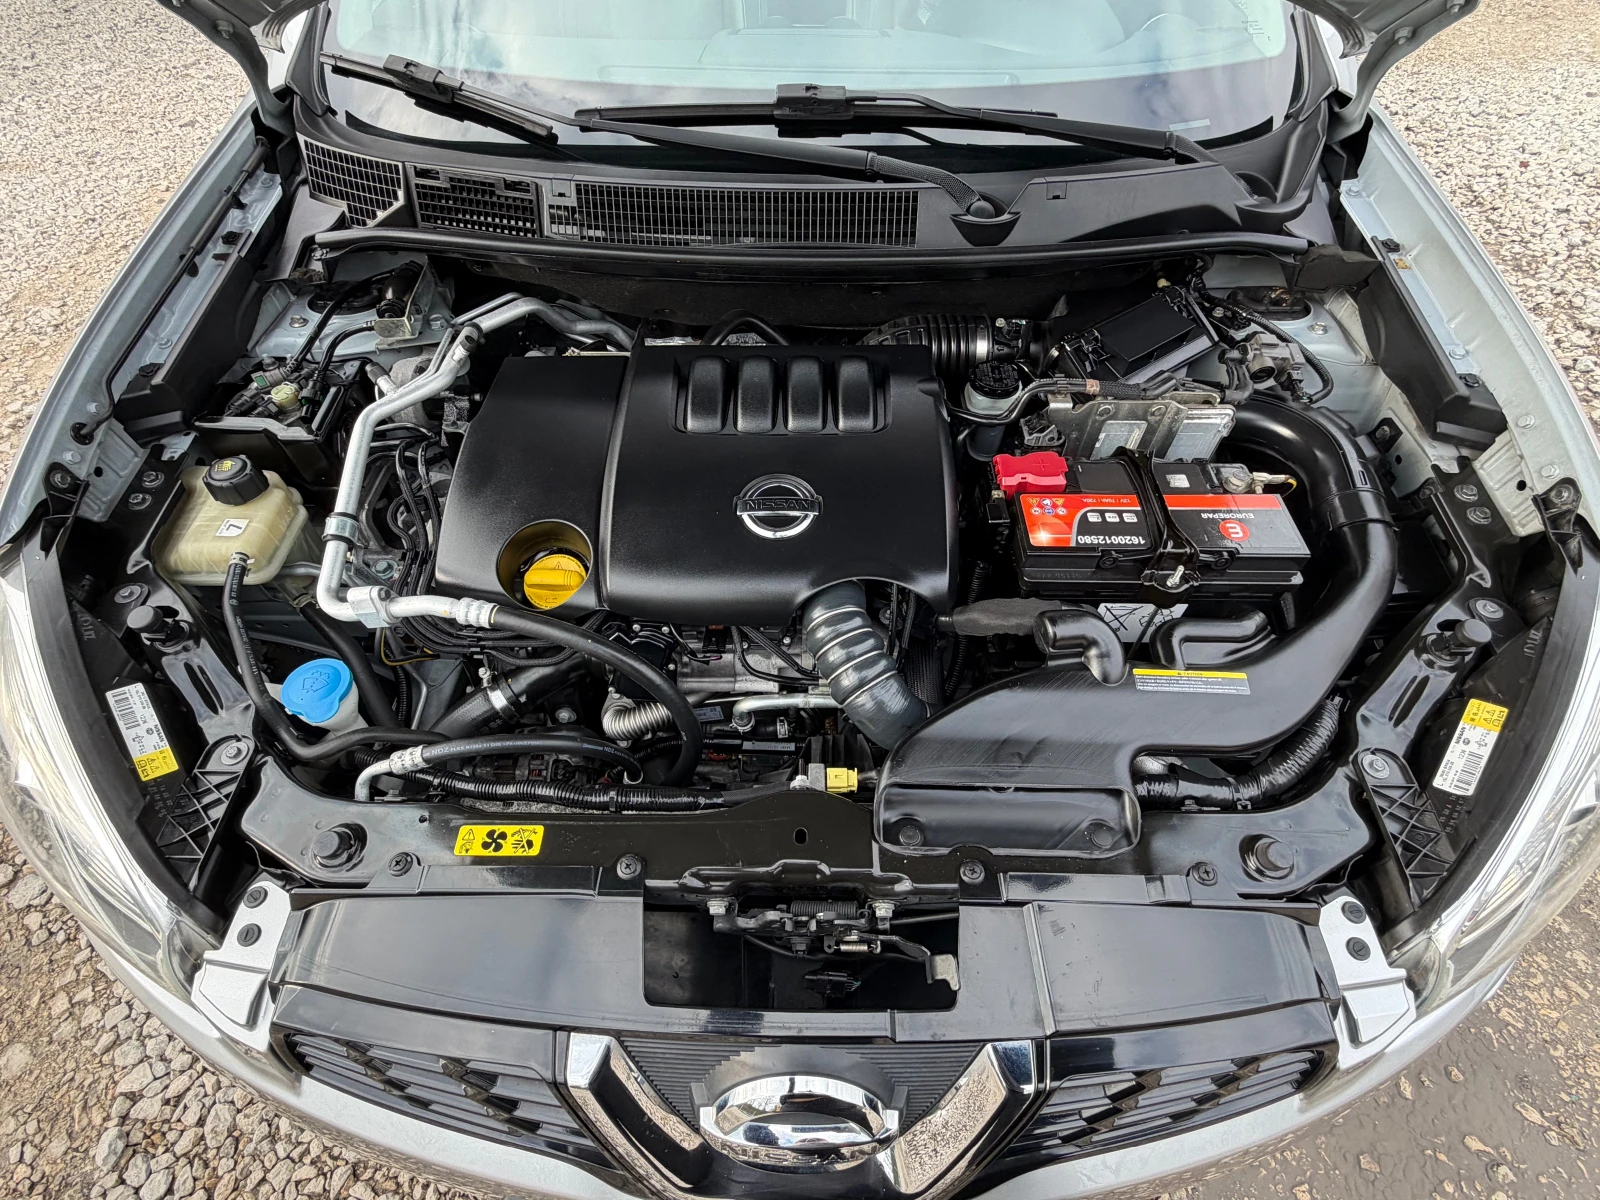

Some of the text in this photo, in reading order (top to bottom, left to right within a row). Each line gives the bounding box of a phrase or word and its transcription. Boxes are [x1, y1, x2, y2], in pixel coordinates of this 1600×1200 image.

[746, 500, 811, 510] NISSAN
[1077, 535, 1146, 545] 1620012580
[431, 747, 450, 756] NDZ
[721, 1143, 879, 1165] NISSAN
